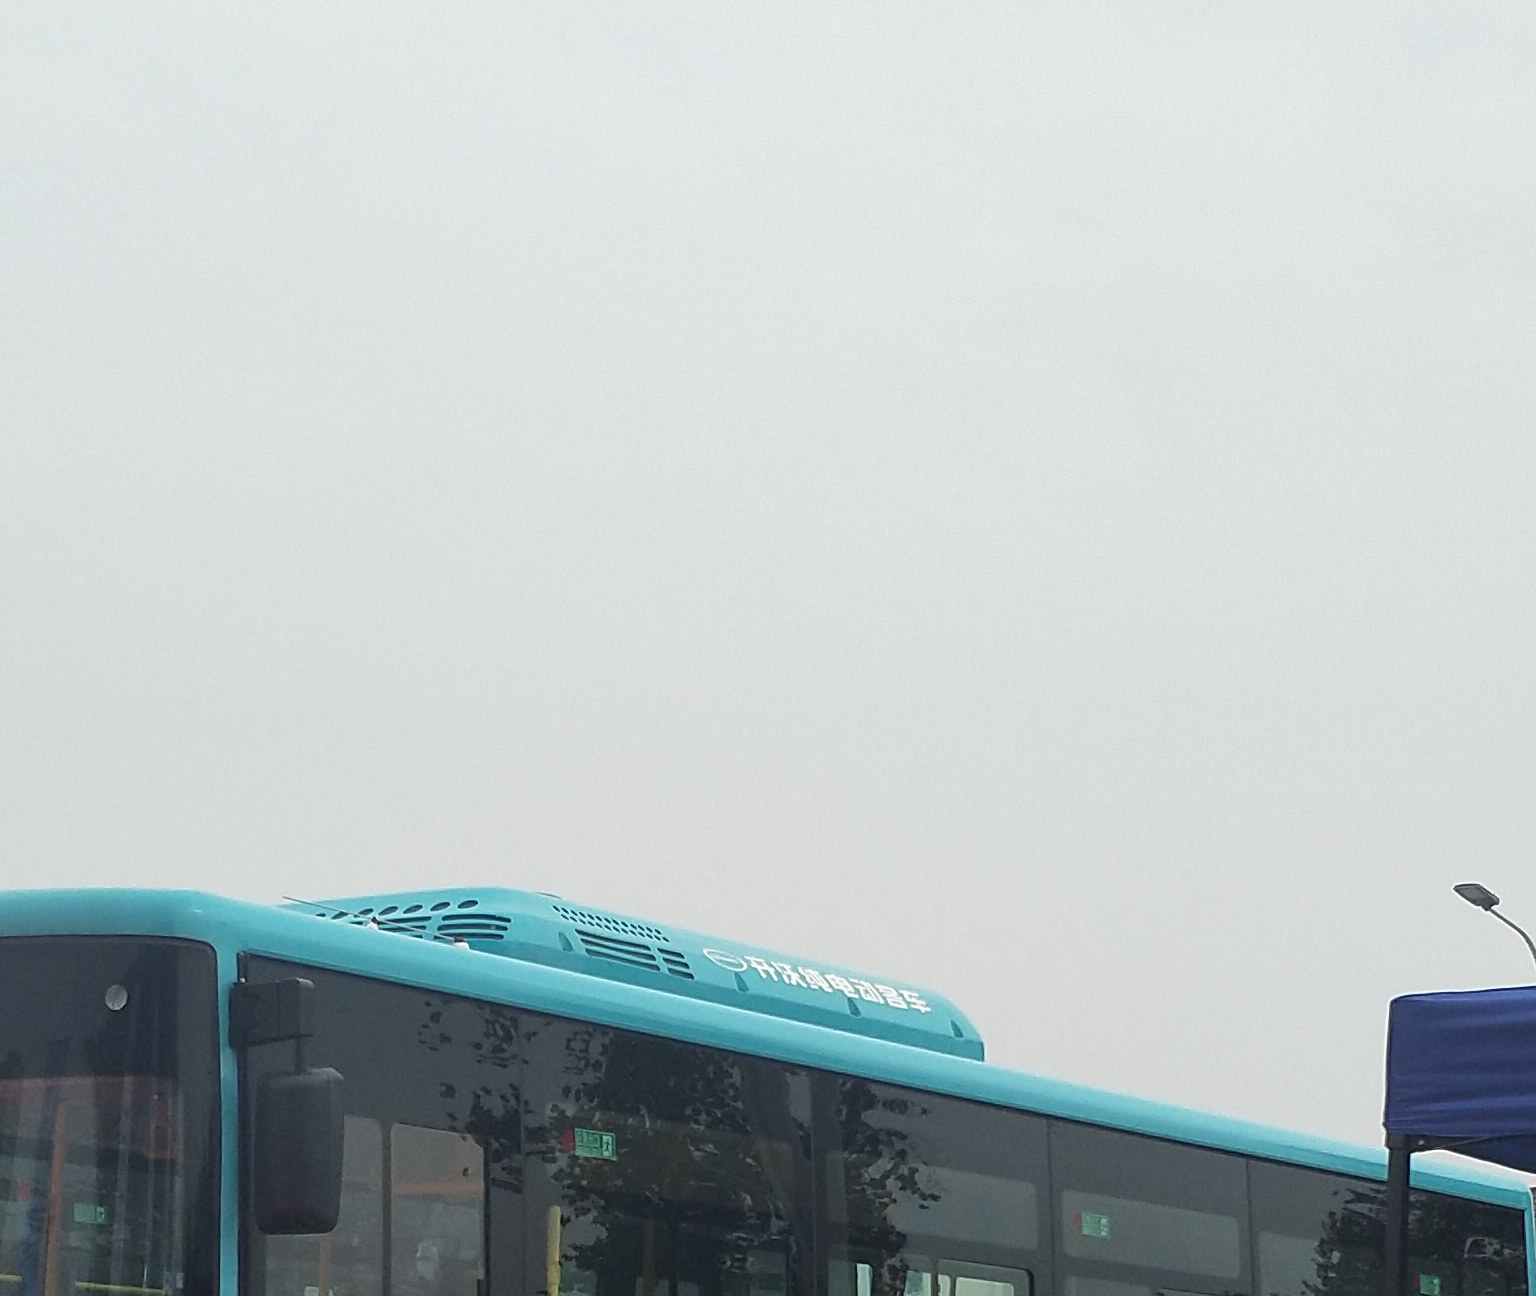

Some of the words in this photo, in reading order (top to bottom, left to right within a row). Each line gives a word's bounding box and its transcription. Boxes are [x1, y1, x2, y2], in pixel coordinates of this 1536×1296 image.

[743, 954, 932, 1014] 开沃纯电动客车
